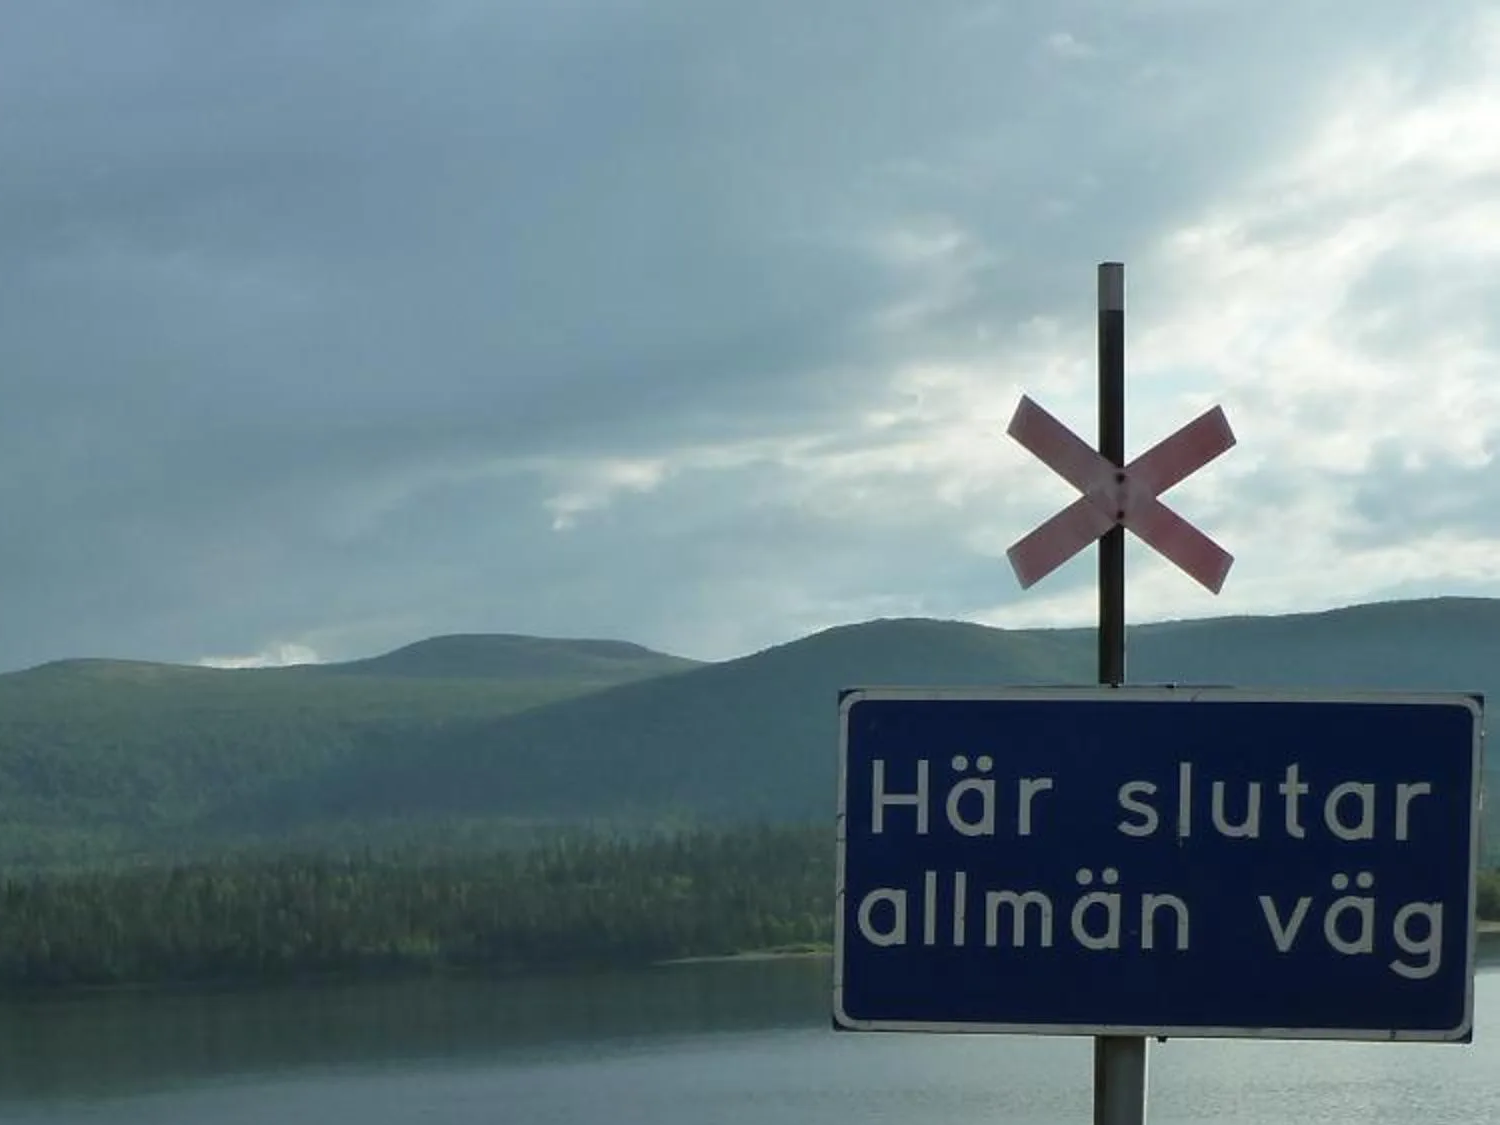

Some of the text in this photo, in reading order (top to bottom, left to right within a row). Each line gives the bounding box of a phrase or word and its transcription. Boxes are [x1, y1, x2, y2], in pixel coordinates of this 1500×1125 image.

[871, 755, 1431, 841] Här slutar
[857, 867, 1444, 979] allmän väg
